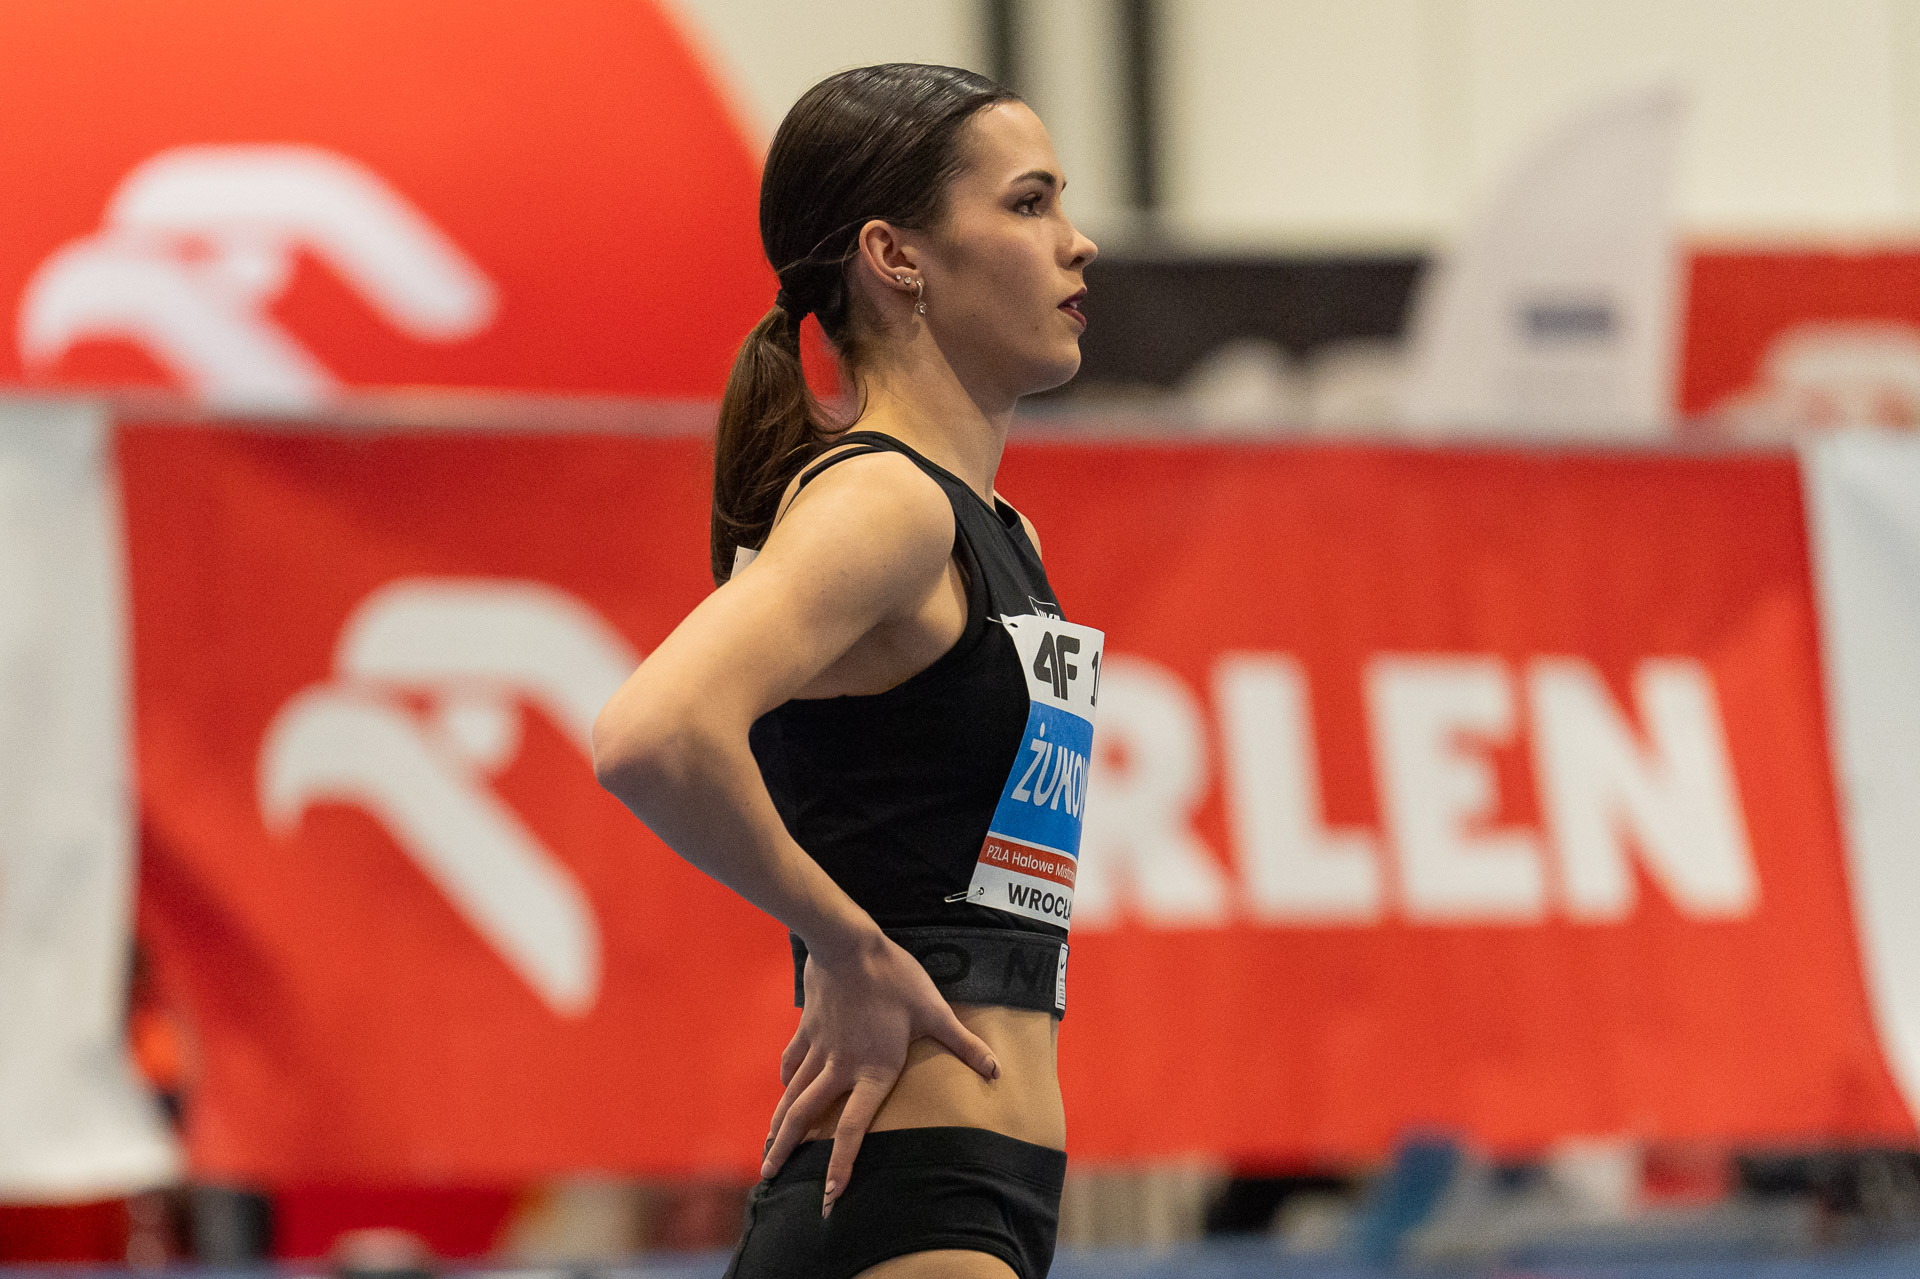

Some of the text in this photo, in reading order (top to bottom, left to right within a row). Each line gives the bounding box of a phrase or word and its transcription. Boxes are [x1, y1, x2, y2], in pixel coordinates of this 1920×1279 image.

[1090, 650, 1102, 707] 1
[1070, 648, 1760, 930] RLEN
[986, 845, 1010, 863] PZLA
[1011, 851, 1055, 874] Halowe
